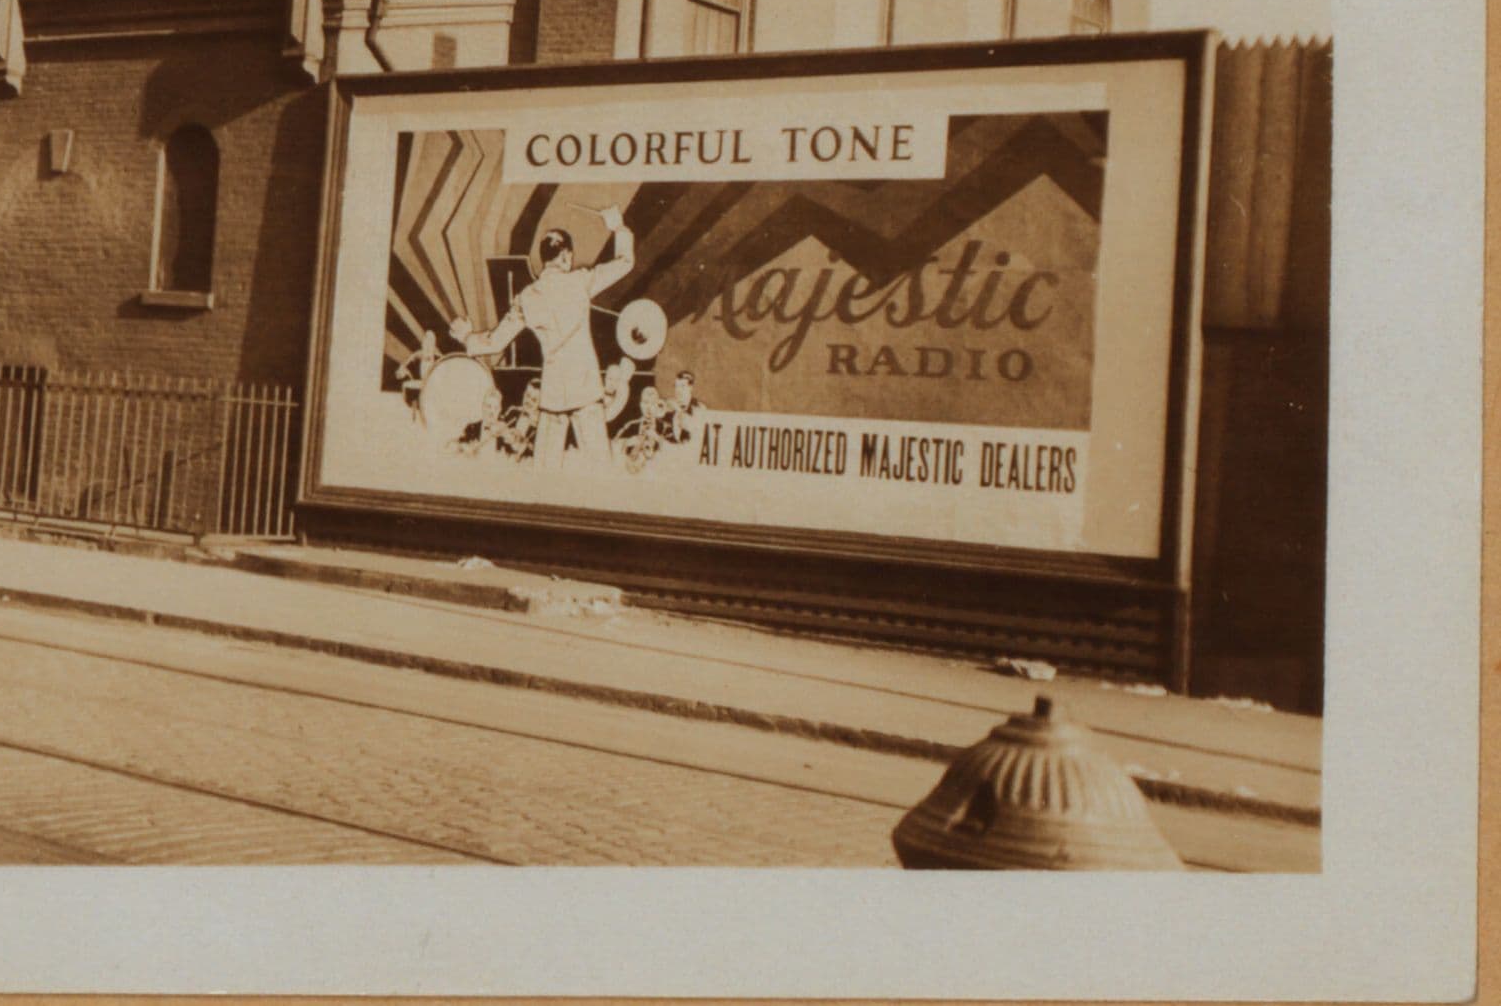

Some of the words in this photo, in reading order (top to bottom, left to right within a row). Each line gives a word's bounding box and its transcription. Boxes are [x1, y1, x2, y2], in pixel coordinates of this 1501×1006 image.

[525, 129, 752, 167] COLORFUL
[782, 125, 915, 163] TONE
[825, 343, 1034, 382] RADIO
[699, 423, 722, 466] AT
[731, 425, 848, 475] AUTHORIZED
[860, 433, 964, 485] MAJESTIC
[979, 442, 1077, 493] DEALERS
